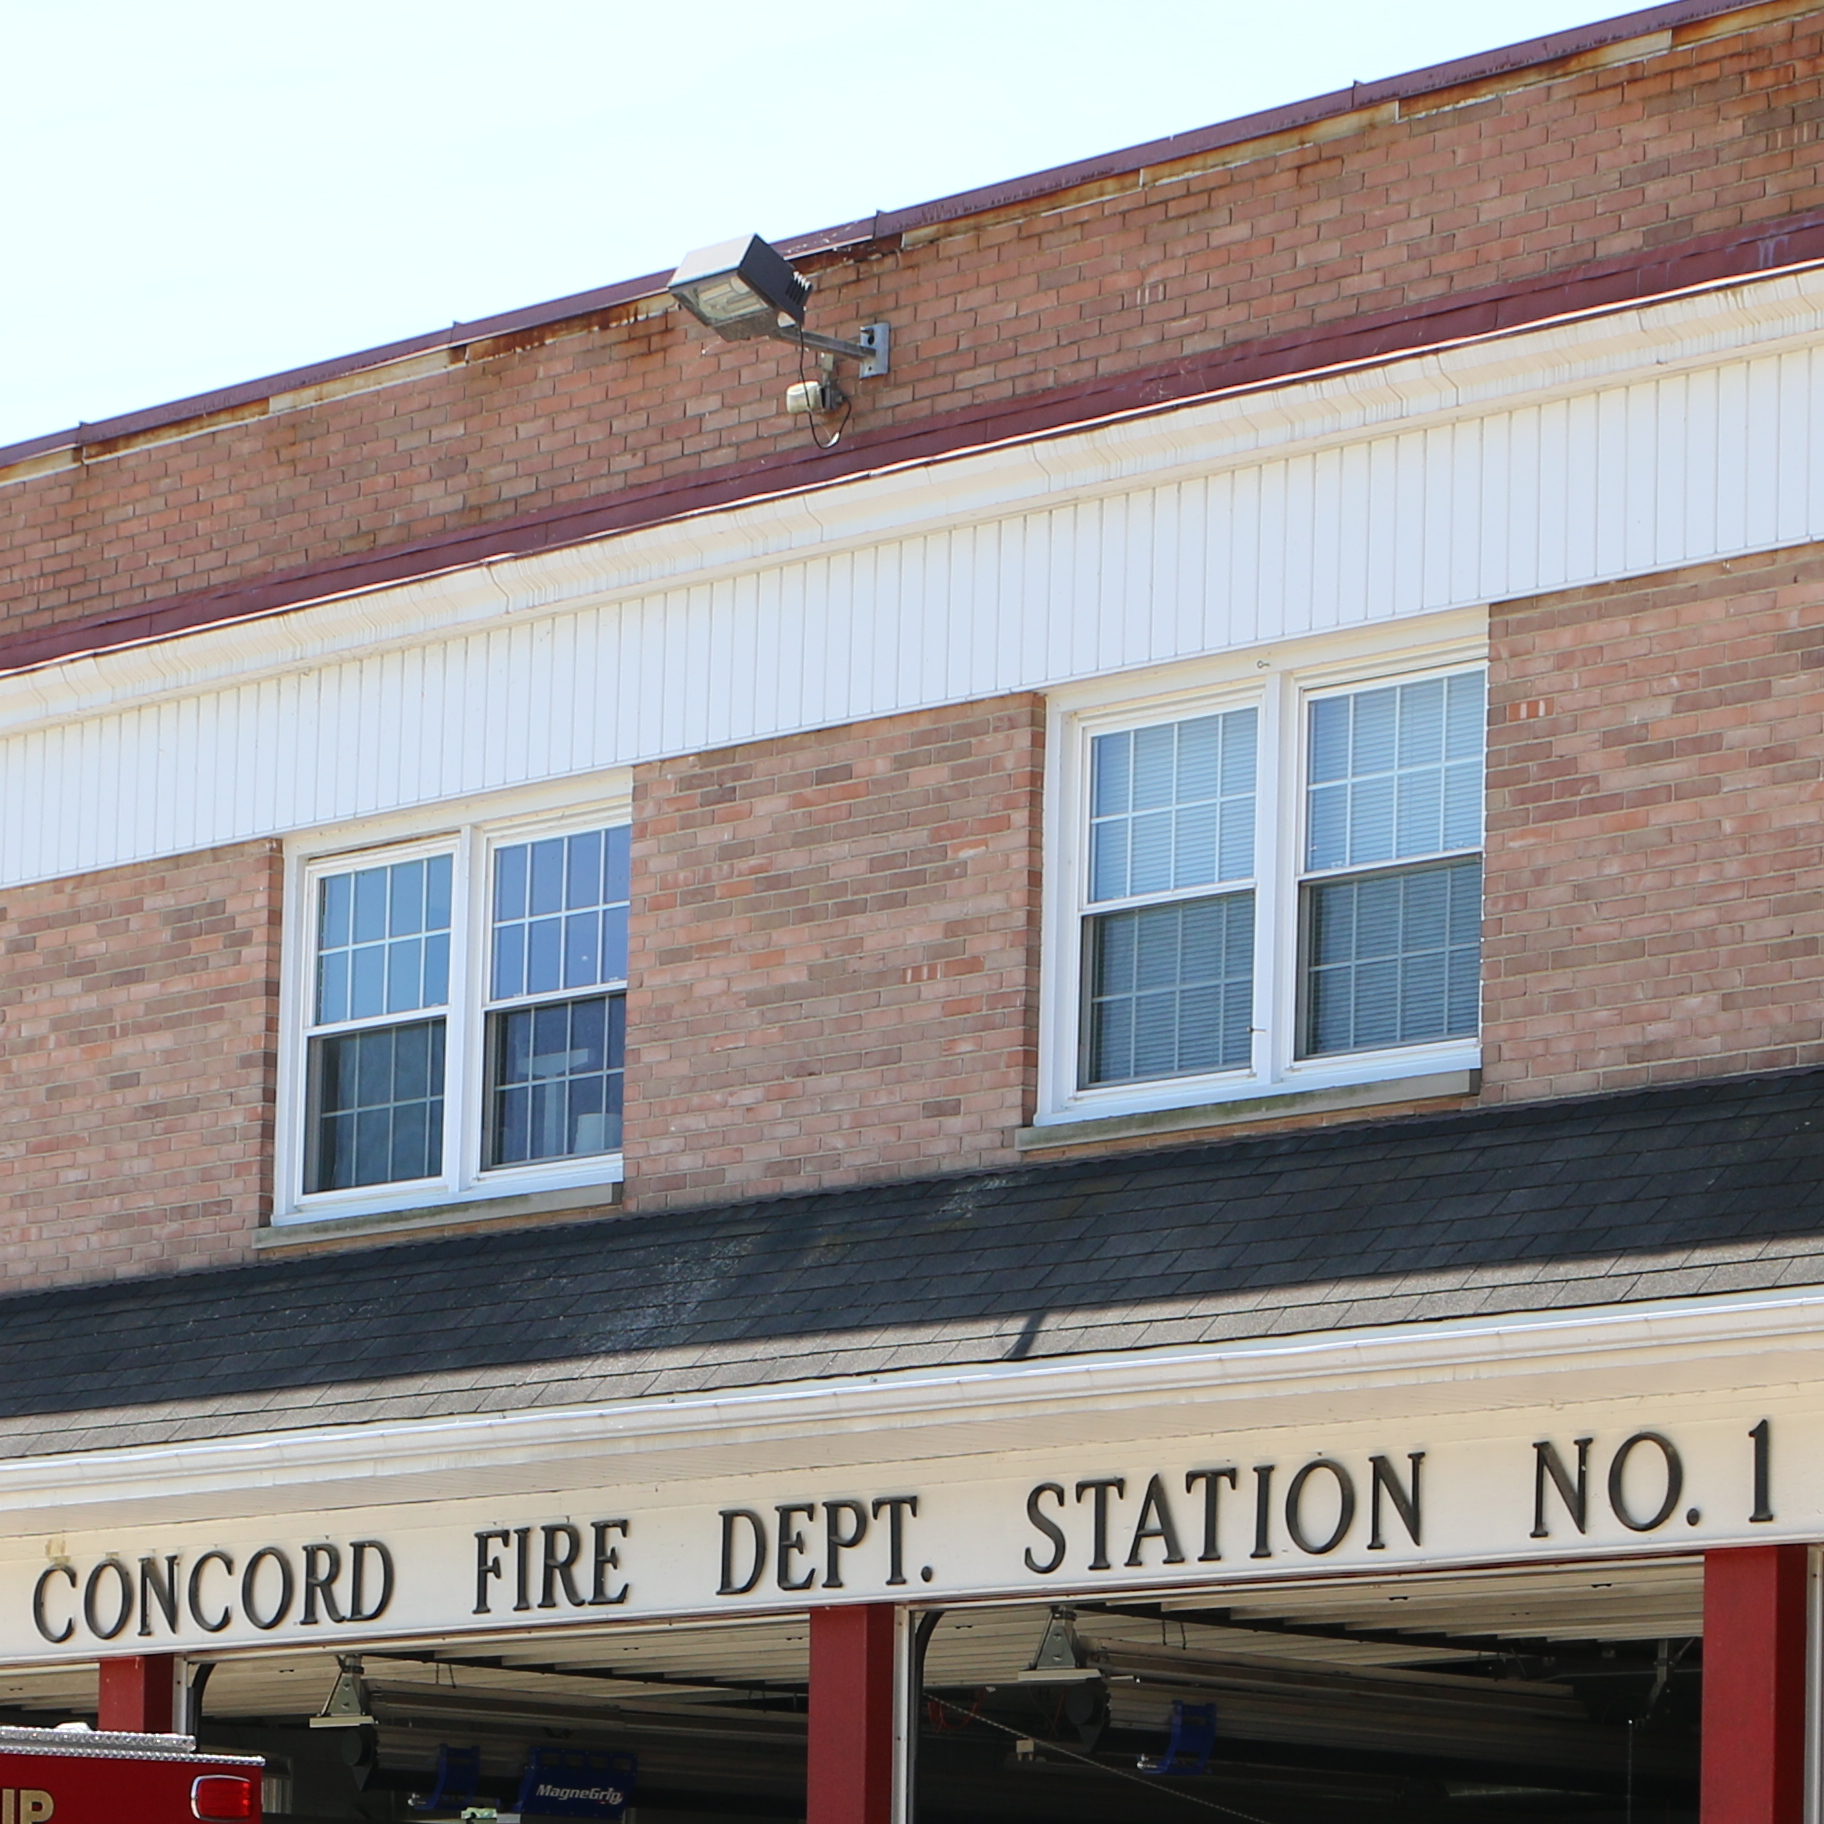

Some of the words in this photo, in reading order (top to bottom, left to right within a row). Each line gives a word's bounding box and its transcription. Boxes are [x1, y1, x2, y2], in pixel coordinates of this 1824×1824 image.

[32, 1539, 395, 1645] CONCORD
[472, 1518, 630, 1614] FIRE
[716, 1494, 933, 1596] DEPT.
[1023, 1450, 1427, 1575] STATION
[1529, 1432, 1701, 1539] NO.
[1747, 1418, 1775, 1523] 1
[535, 1783, 624, 1805] MagneGrip
